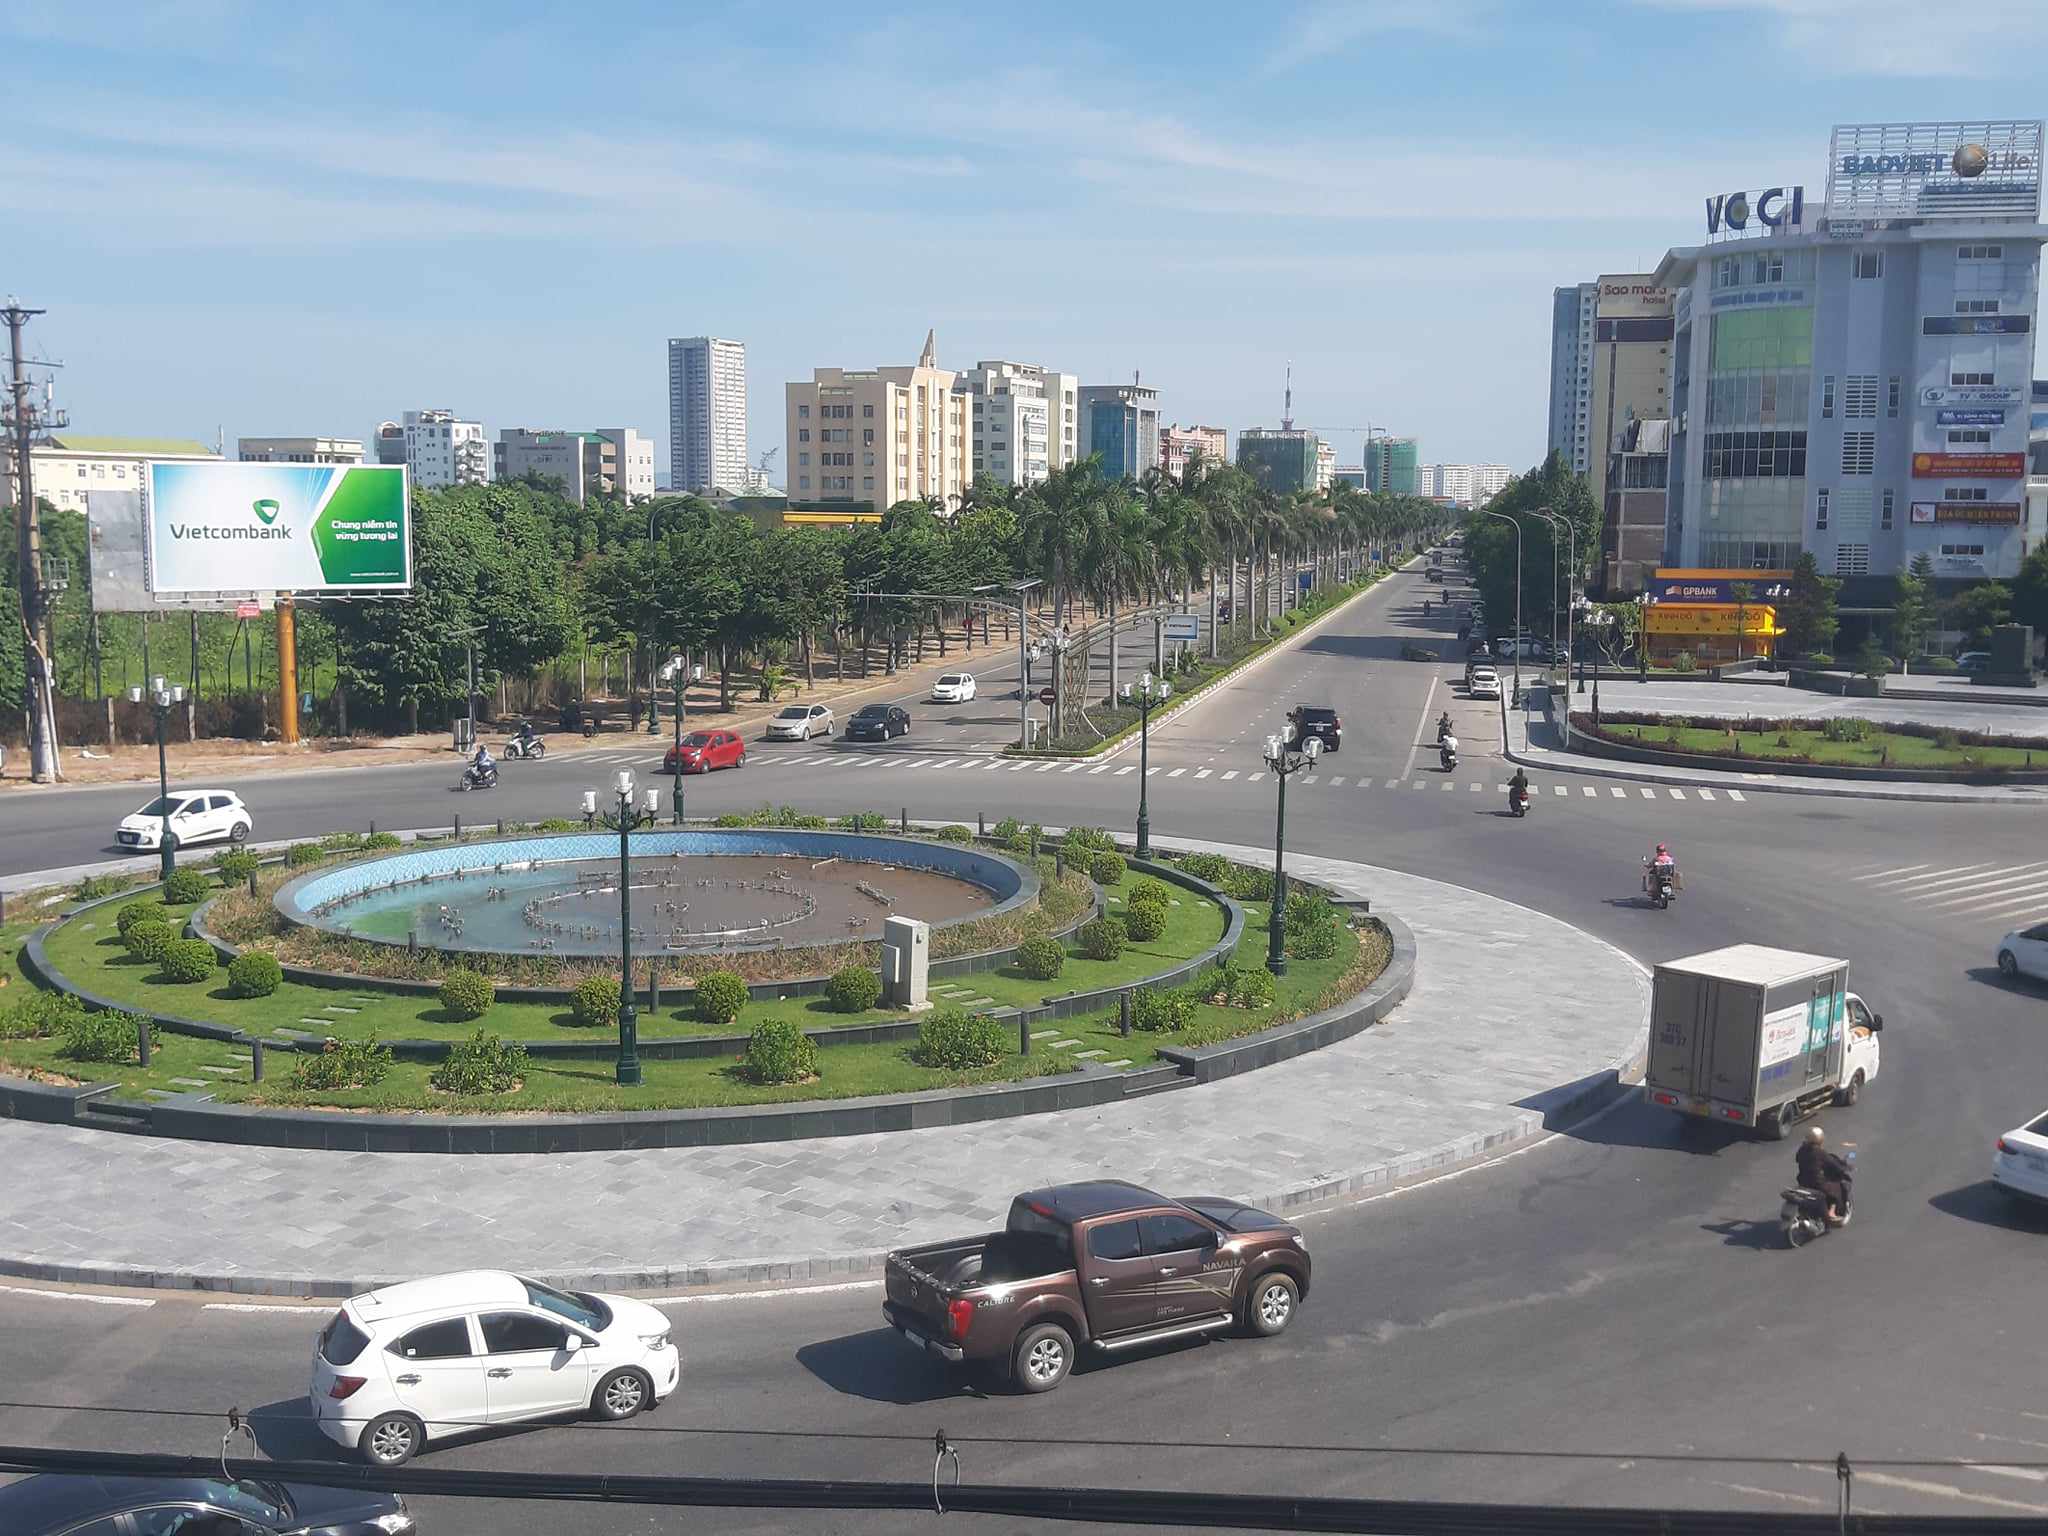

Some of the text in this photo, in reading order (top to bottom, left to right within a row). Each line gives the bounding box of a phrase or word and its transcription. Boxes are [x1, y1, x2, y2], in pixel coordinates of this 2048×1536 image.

[1706, 186, 1804, 234] VCCI
[1605, 285, 1629, 295] Sao
[331, 520, 360, 530] Chung
[385, 520, 398, 528] tin
[170, 523, 292, 540] Vietcombank
[1683, 586, 1717, 595] GPBANK
[1203, 1258, 1246, 1272] NAVARA
